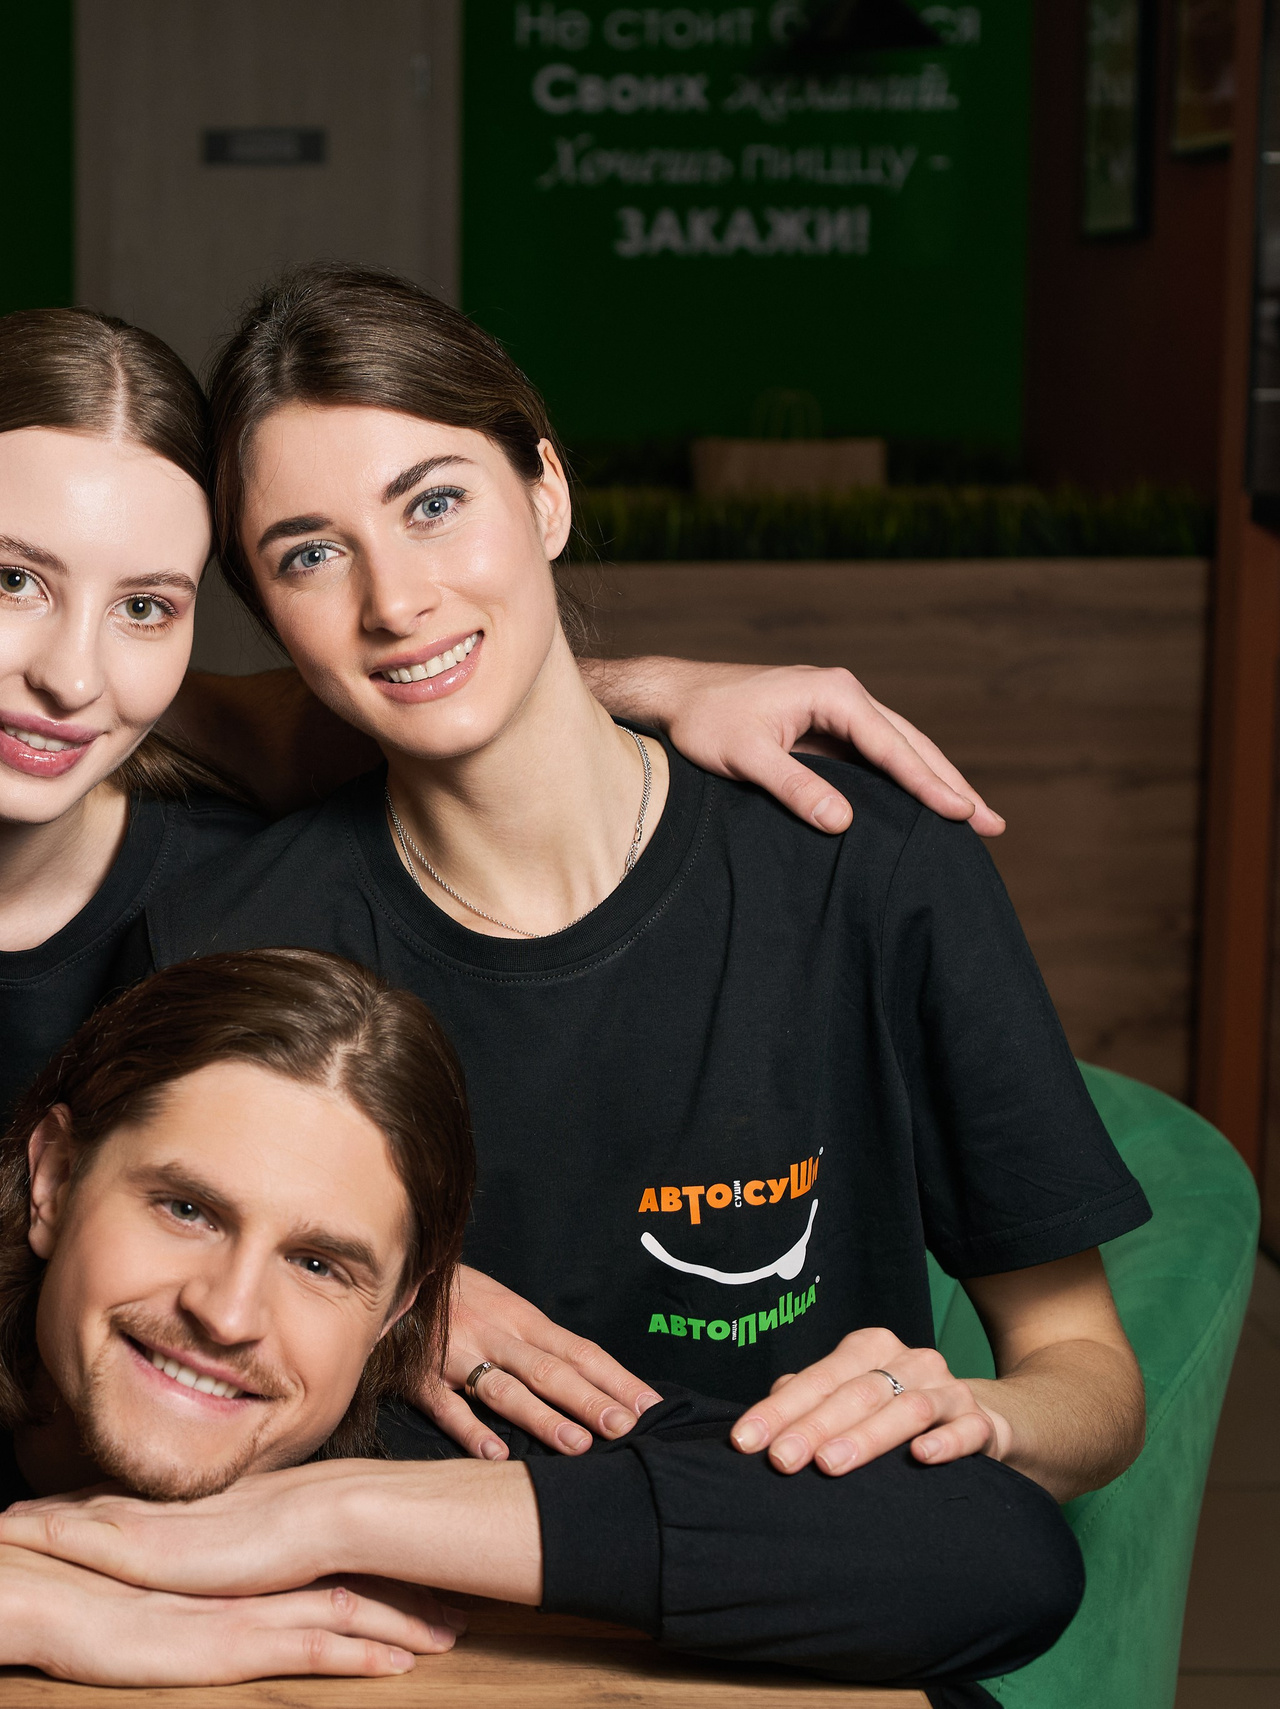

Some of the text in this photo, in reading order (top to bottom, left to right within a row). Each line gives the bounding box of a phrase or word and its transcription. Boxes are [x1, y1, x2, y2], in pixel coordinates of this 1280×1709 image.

[515, 2, 592, 50] Не
[603, 7, 755, 50] стоит
[532, 63, 709, 114] Своих
[614, 205, 870, 258] ЗАКАЖИ!
